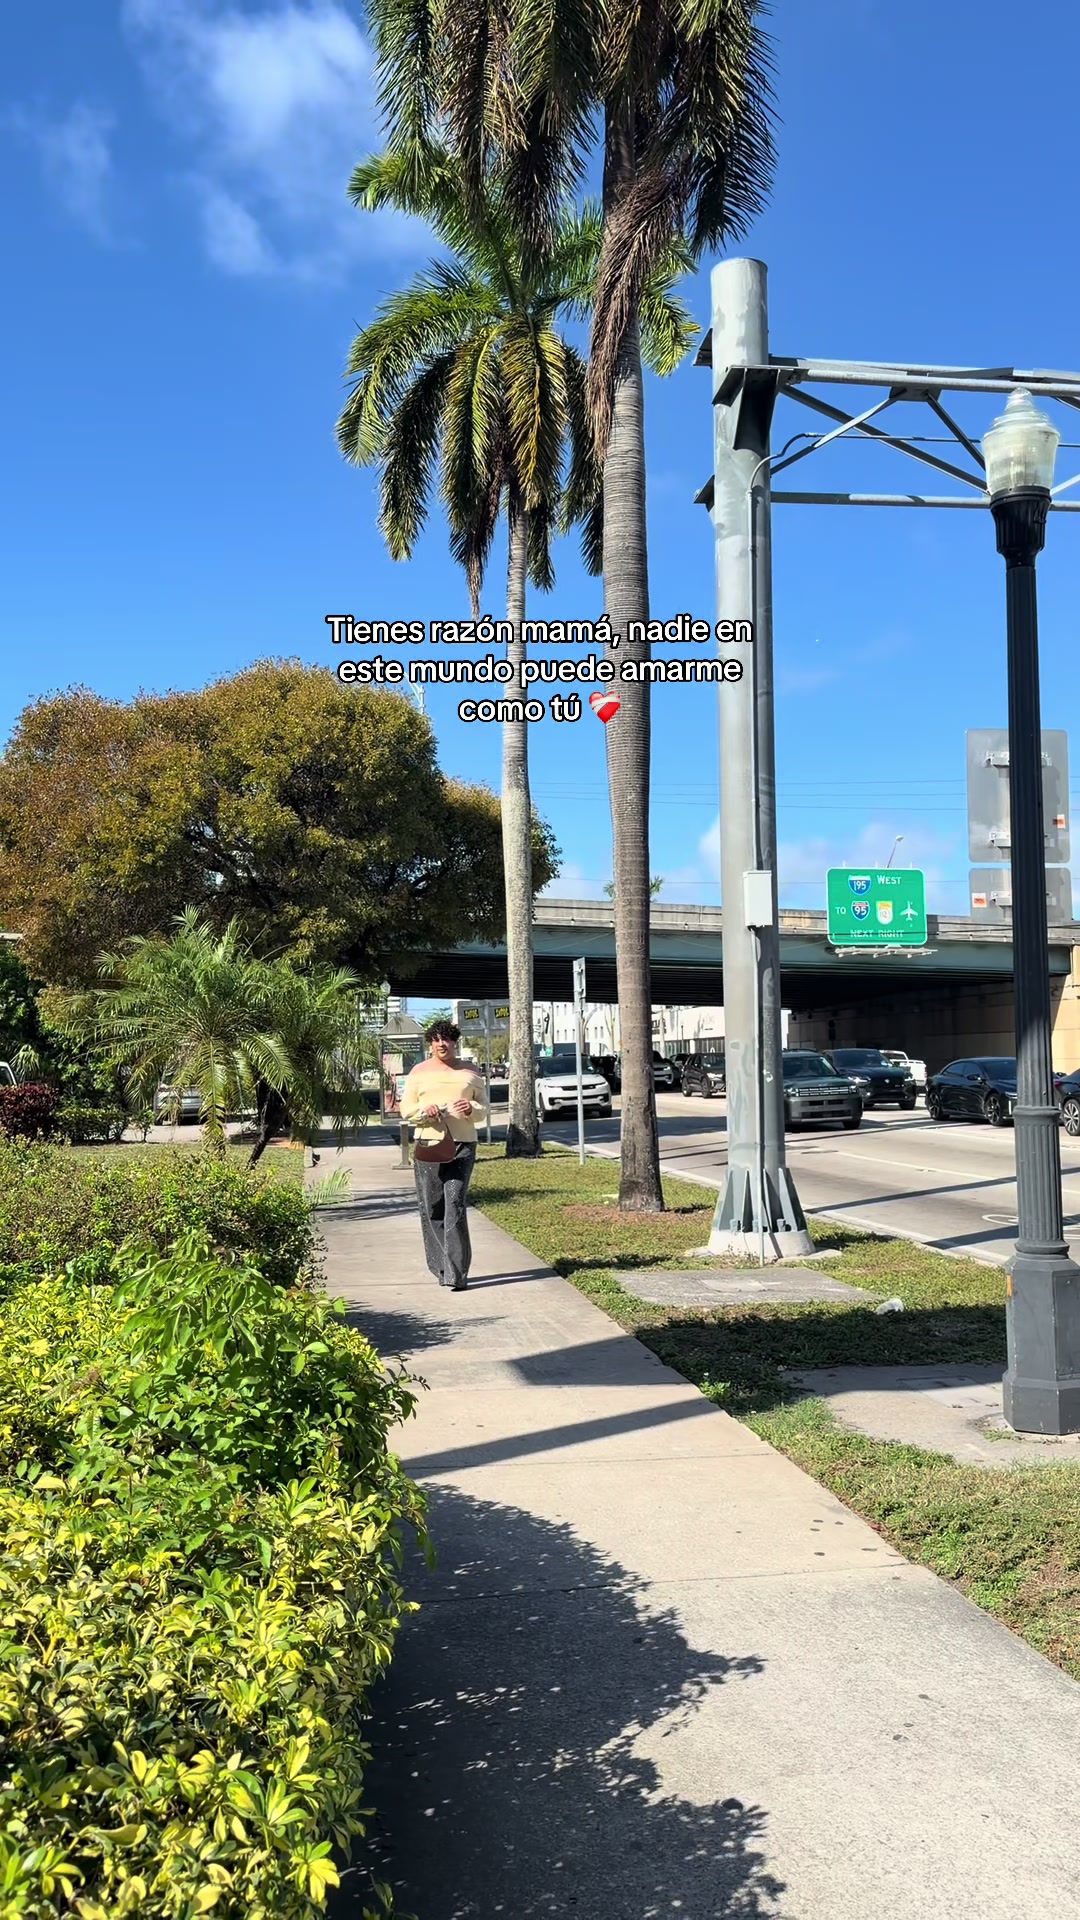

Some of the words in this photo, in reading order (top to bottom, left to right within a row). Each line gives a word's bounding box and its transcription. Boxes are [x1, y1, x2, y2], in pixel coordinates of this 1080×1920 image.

[853, 880, 867, 891] 195
[876, 875, 902, 885] WEST
[835, 906, 847, 915] TO
[854, 906, 867, 916] 95
[850, 929, 874, 938] NEXT
[878, 929, 905, 938] RIGHT
